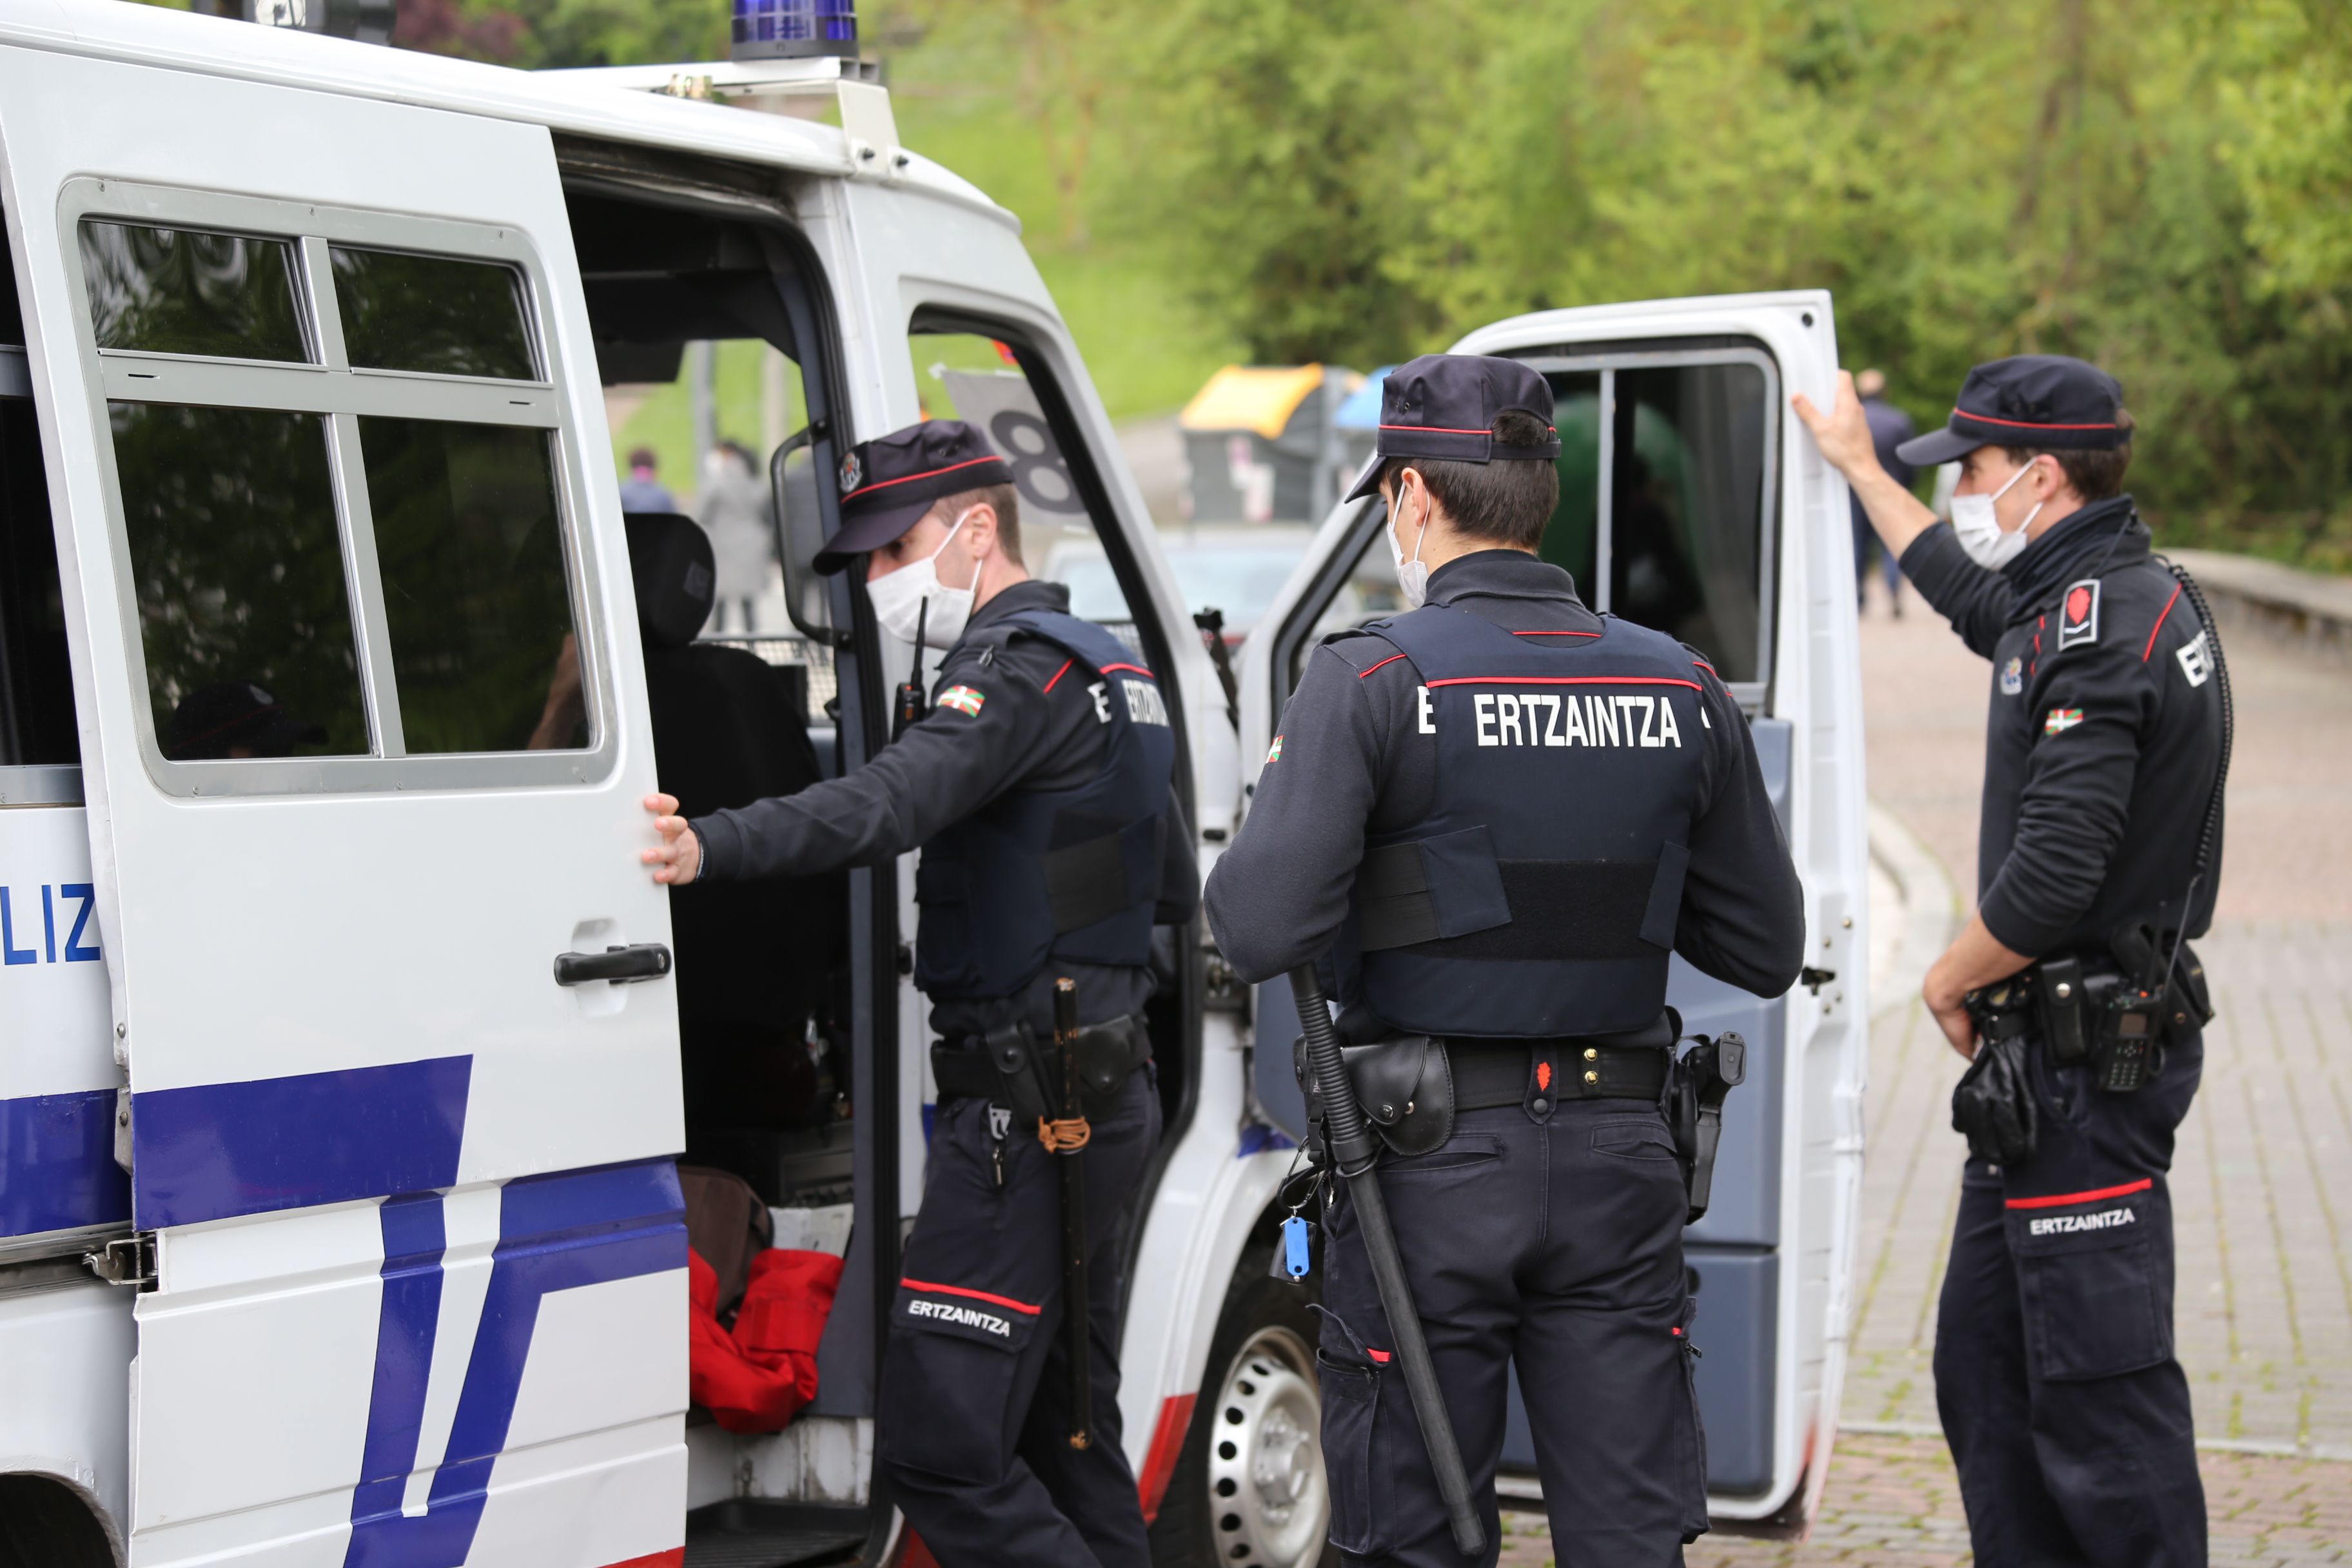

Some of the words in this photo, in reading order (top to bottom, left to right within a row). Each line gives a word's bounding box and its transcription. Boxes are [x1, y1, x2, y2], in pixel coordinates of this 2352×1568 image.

[1474, 693, 1681, 747] ERTZAINTZA
[0, 883, 101, 965] LIZ
[2030, 1207, 2135, 1235] ERTZAINTZA
[908, 1299, 1010, 1337] ERTZAINTZA
